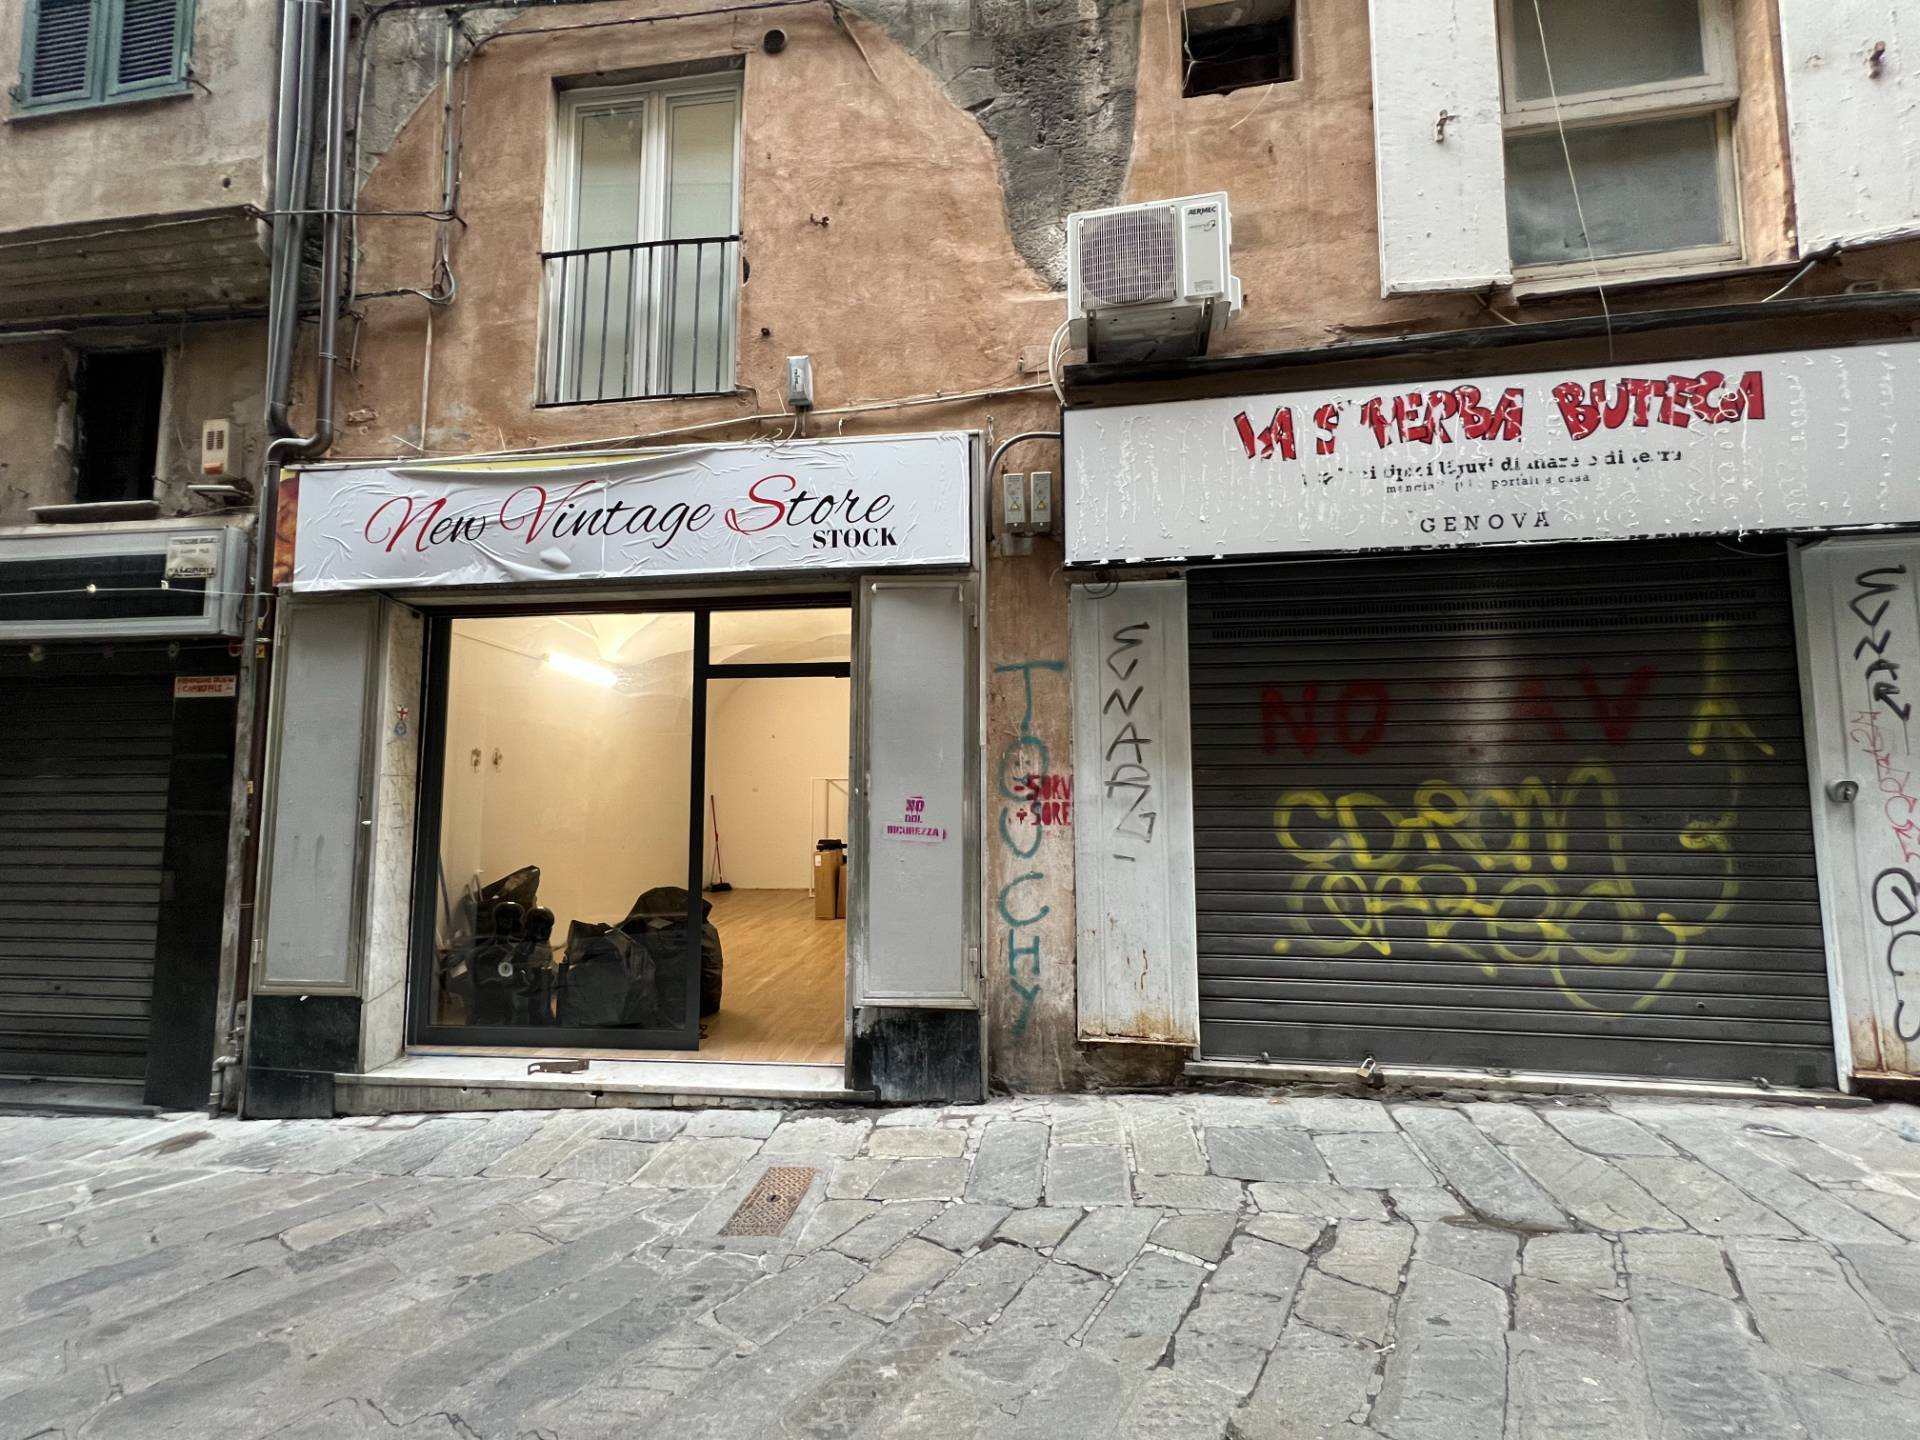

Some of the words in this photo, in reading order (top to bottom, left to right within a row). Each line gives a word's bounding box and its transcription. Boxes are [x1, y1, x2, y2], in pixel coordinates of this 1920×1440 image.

[1187, 205, 1217, 216] AERMEC
[1552, 370, 1766, 441] BUTEGA
[364, 496, 486, 552] New
[501, 480, 715, 549] Vintage
[724, 474, 895, 535] Store
[1420, 511, 1550, 533] GENOVA
[812, 527, 898, 549] STOCK
[1261, 680, 1393, 755] NO
[905, 799, 925, 812] NO
